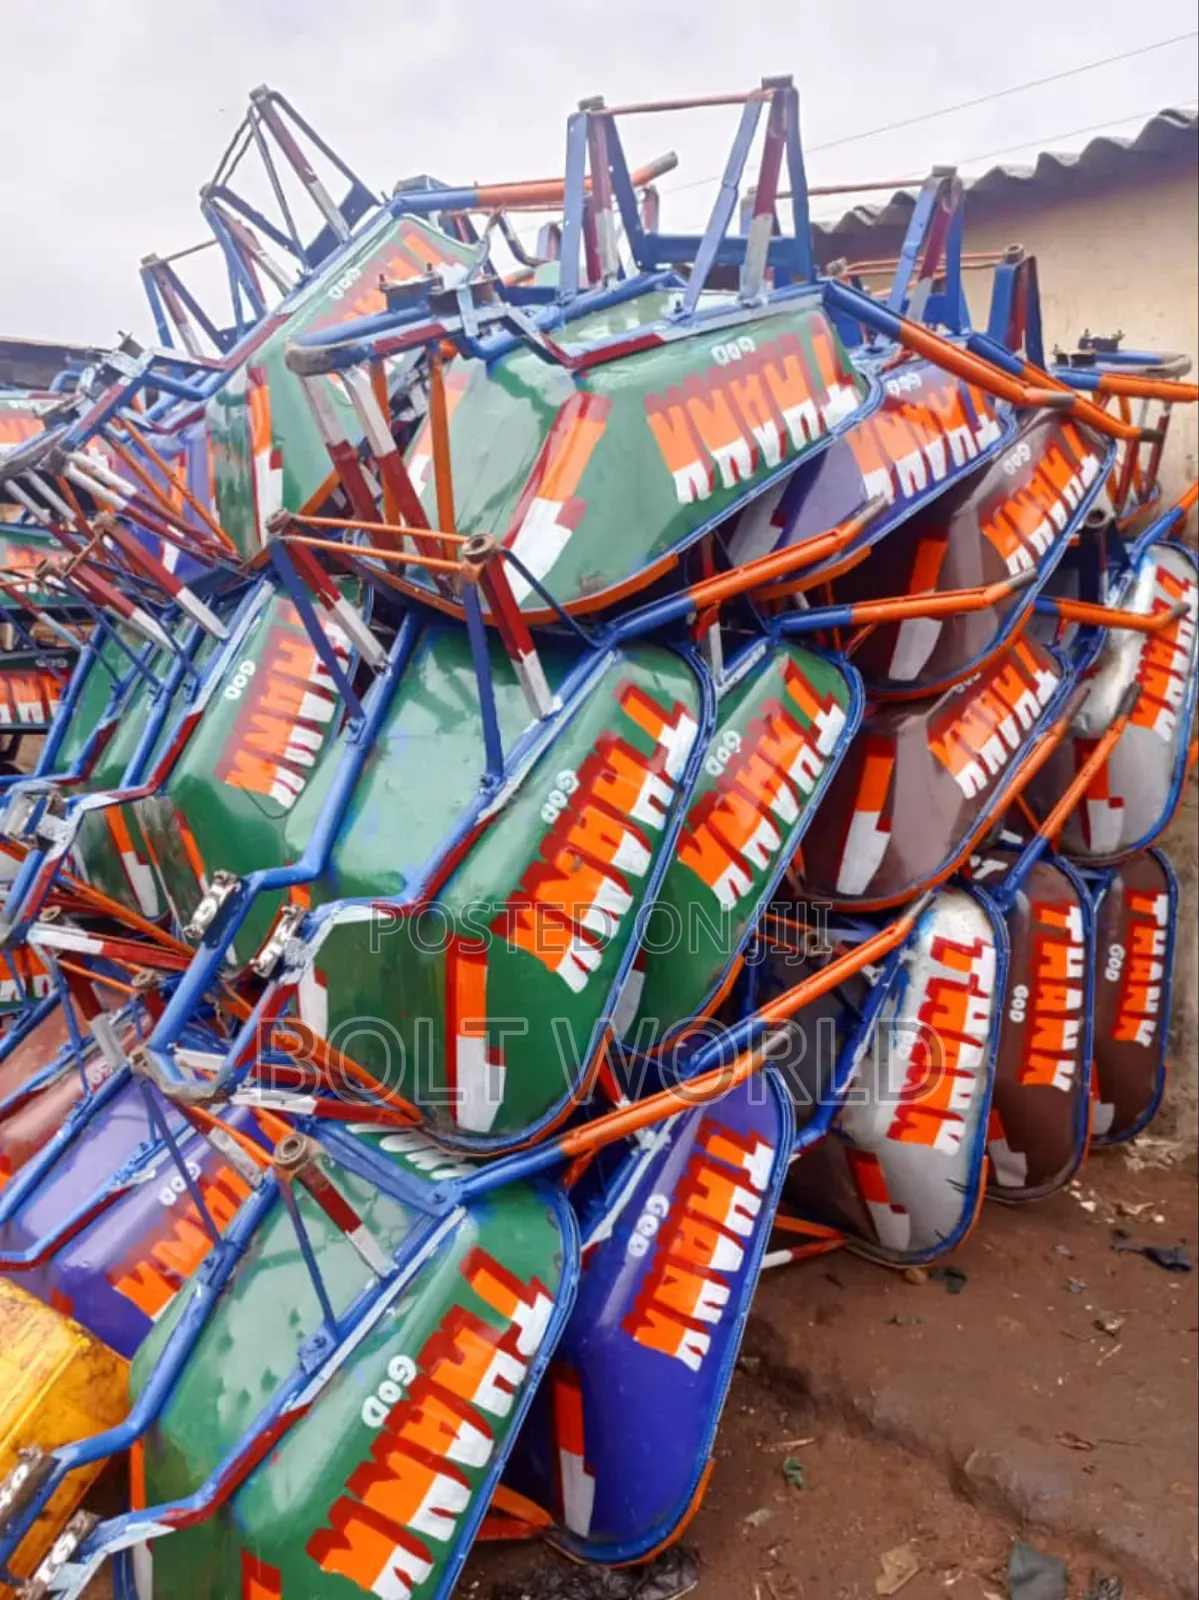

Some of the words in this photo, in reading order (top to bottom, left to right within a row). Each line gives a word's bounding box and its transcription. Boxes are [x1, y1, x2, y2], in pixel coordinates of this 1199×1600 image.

[645, 318, 860, 503] THANK
[711, 338, 755, 365] GOD
[845, 378, 1003, 502] THANK
[981, 420, 1099, 577] THANK
[1003, 442, 1032, 475] GOD
[223, 658, 257, 701] GOD
[926, 638, 1060, 800] THANK
[539, 769, 581, 824] GOD
[676, 657, 846, 912] THANK
[704, 729, 743, 779] GOD
[492, 680, 699, 993] THANK
[1009, 983, 1029, 1025] GOD
[1016, 900, 1084, 1092] THANK
[1104, 942, 1125, 983] GOD
[1112, 888, 1169, 1048] THANK
[886, 934, 997, 1157] THANK
[622, 1117, 775, 1373] THANK
[626, 1193, 670, 1258] GOD
[304, 1245, 555, 1600] THANK
[360, 1353, 417, 1429] GOD
